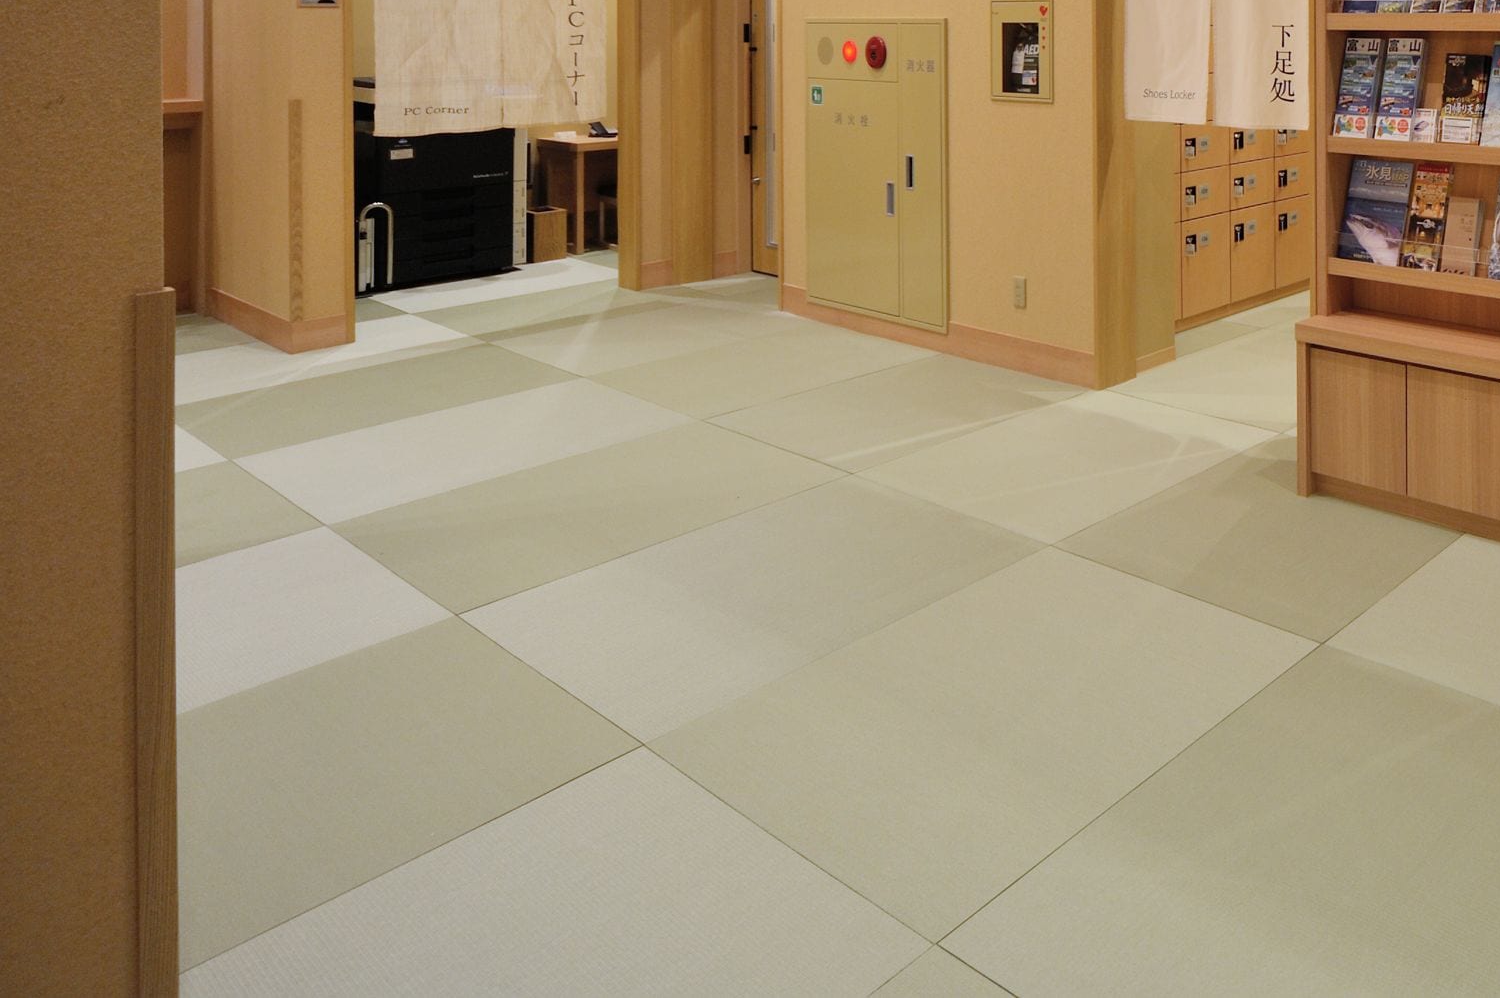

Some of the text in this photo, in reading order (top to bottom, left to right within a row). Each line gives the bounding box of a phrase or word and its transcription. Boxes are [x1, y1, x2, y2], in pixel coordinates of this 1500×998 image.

[1023, 44, 1040, 55] AED
[905, 59, 936, 73] 消火器
[1270, 24, 1295, 103] 下足処
[1143, 88, 1196, 100] Shoes Locker
[404, 106, 470, 116] PC Corner
[834, 112, 870, 127] 消火栓
[1365, 165, 1392, 181] 氷見
